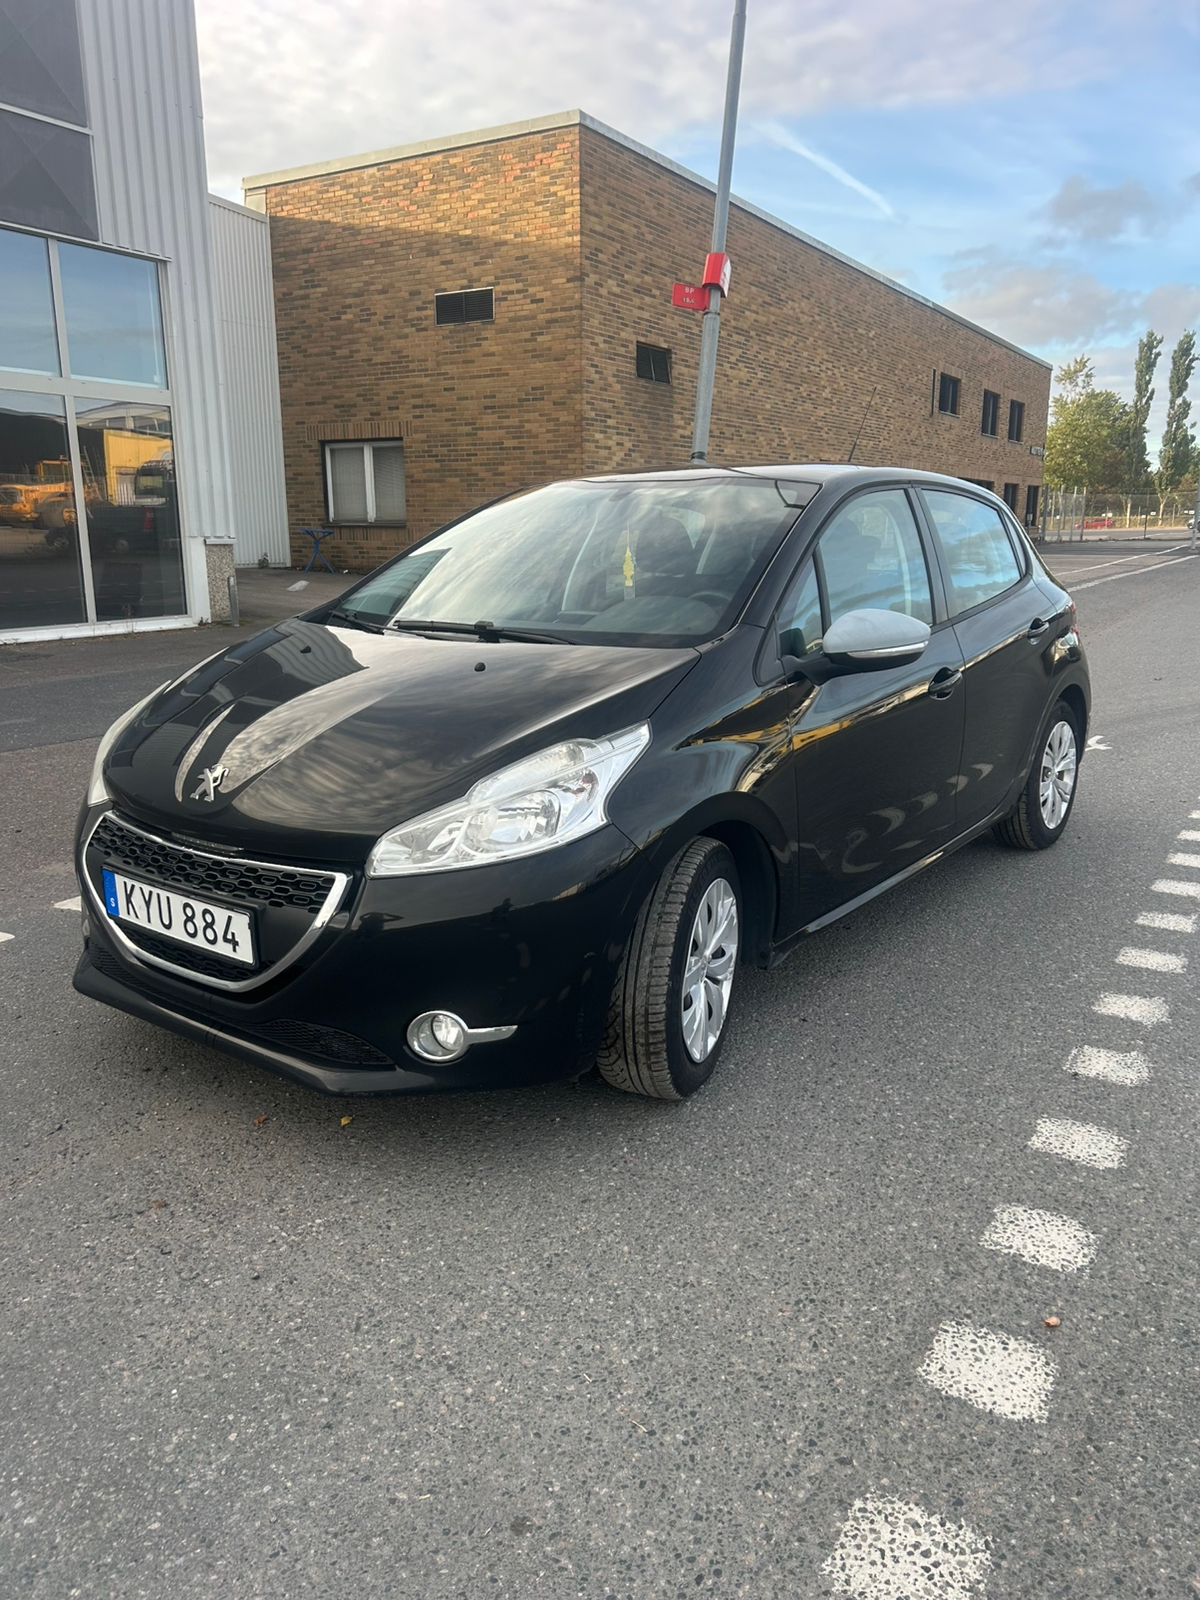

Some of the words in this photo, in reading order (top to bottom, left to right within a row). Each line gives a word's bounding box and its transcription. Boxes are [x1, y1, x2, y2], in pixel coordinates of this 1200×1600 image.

[110, 897, 116, 908] S
[123, 880, 173, 930] KYU
[182, 902, 240, 953] 884
